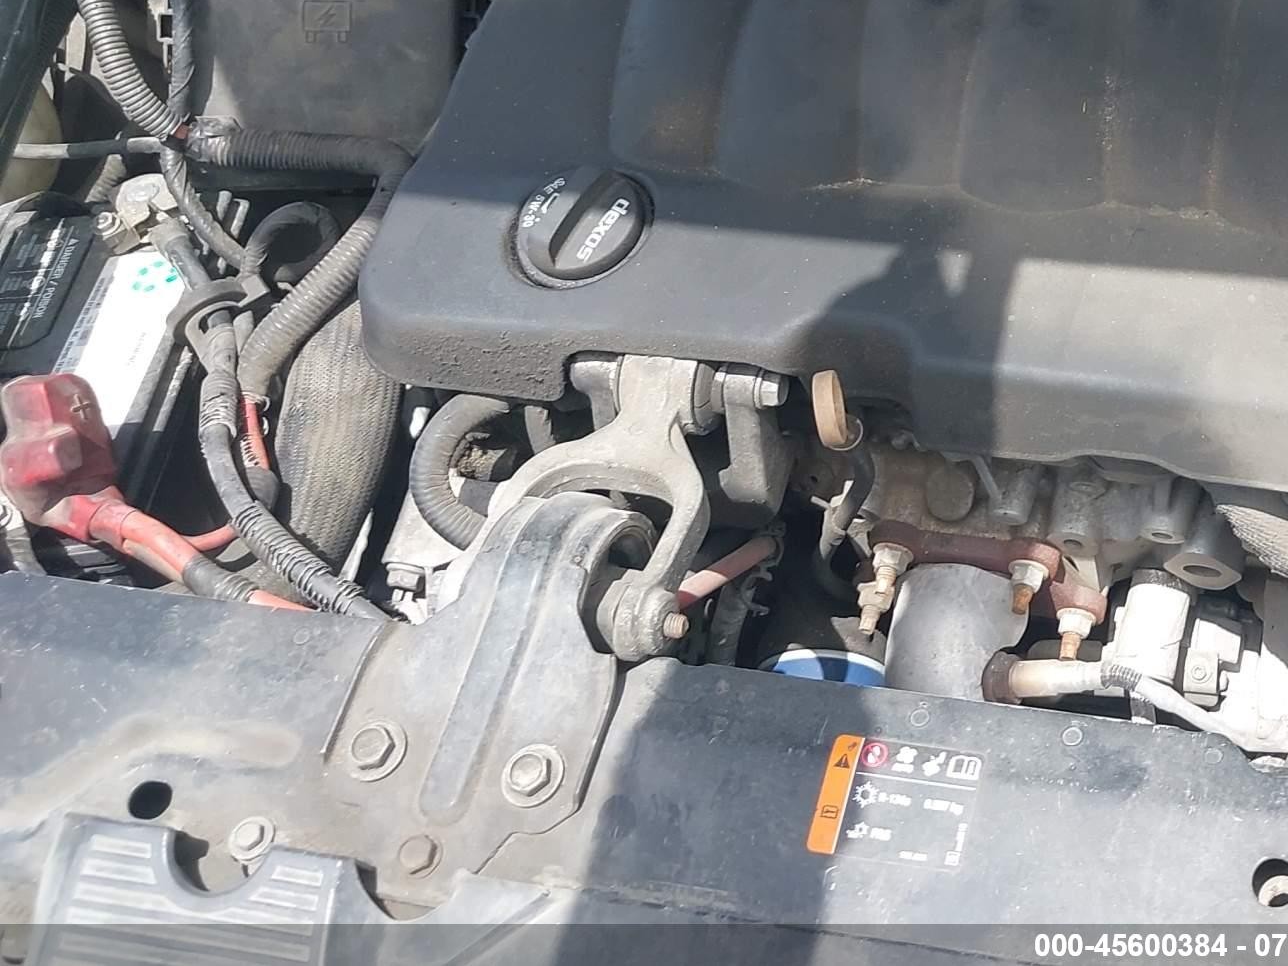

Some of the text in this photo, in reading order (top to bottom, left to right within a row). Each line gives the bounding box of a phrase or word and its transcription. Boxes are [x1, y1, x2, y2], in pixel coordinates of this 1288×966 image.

[521, 177, 566, 228] SAE 5W-30
[576, 198, 630, 263] dexos
